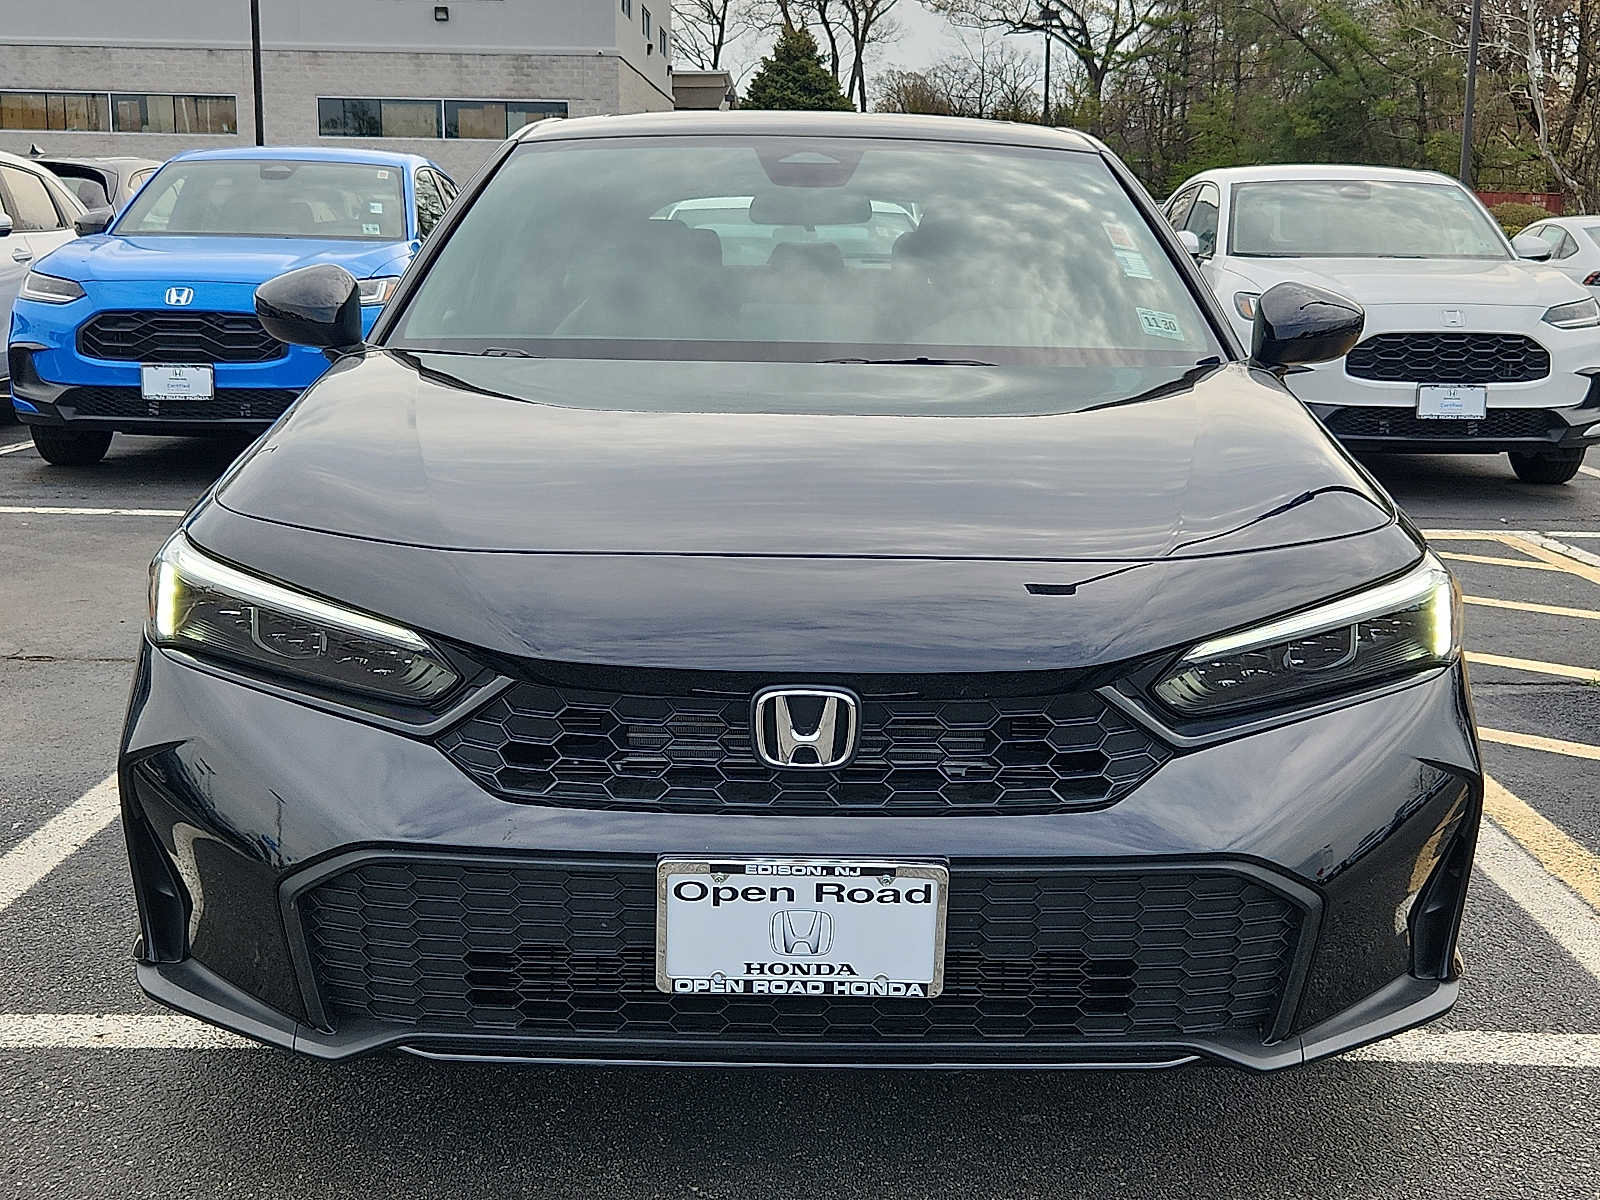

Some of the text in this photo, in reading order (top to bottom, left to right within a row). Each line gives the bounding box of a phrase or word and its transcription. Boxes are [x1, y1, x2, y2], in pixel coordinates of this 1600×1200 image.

[1144, 316, 1177, 331] 11 30
[745, 864, 861, 877] EDISON, NJ
[673, 881, 932, 907] Open Road
[743, 962, 859, 976] HONDA
[674, 979, 924, 997] OPEN ROAD HONDA
